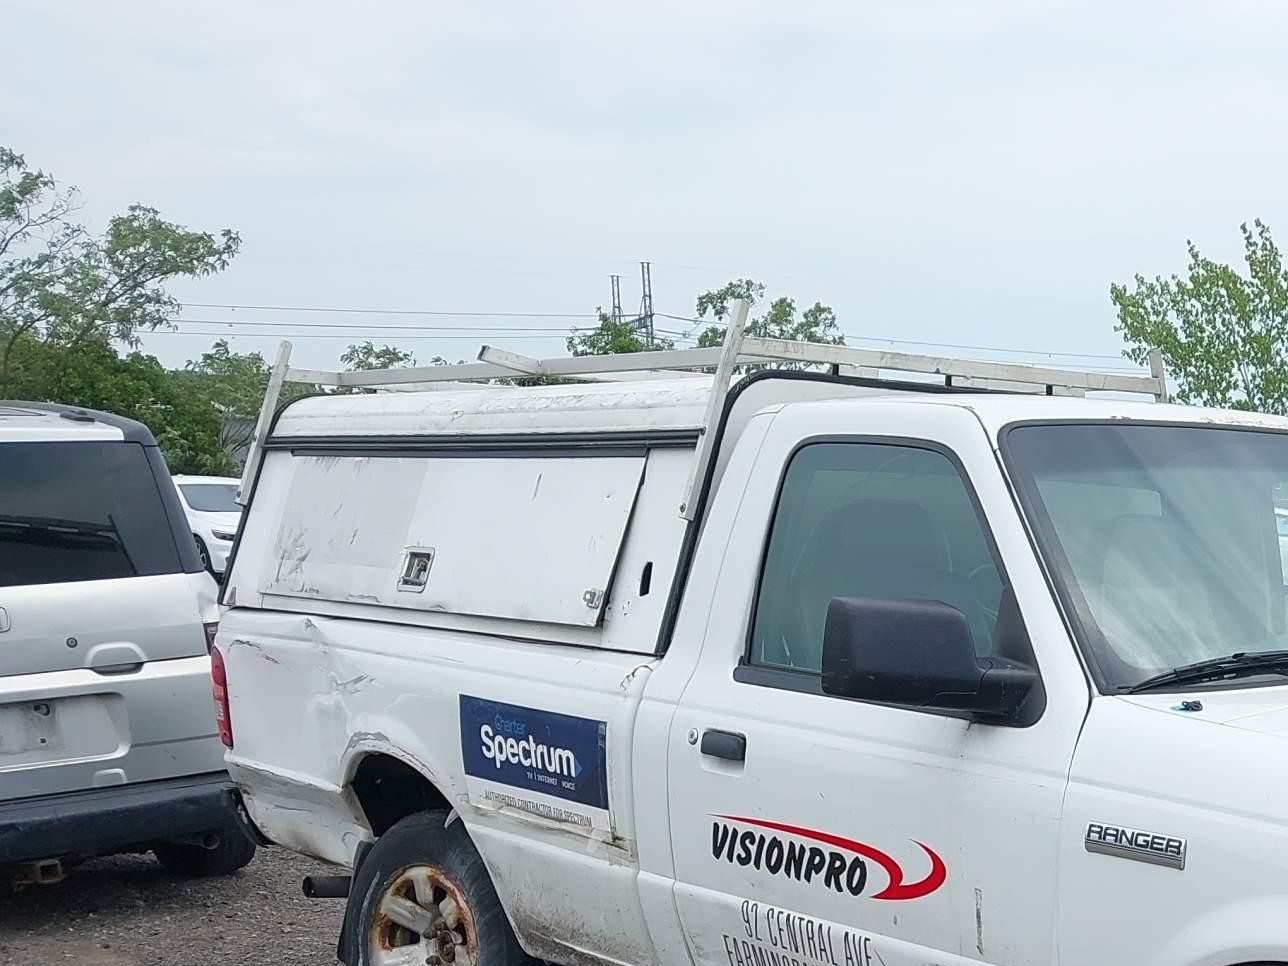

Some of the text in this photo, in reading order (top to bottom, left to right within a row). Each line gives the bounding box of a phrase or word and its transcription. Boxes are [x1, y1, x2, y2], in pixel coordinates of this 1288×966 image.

[480, 724, 576, 777] Spectrum
[561, 780, 576, 791] VOICE
[517, 799, 552, 817] CONTRACTOR
[553, 807, 564, 820] FOR
[564, 810, 593, 828] SPECTRUM
[712, 822, 867, 896] VISIONPRO
[1087, 823, 1183, 855] RANGER
[741, 900, 762, 942] 92
[766, 907, 838, 966] CENTRAL
